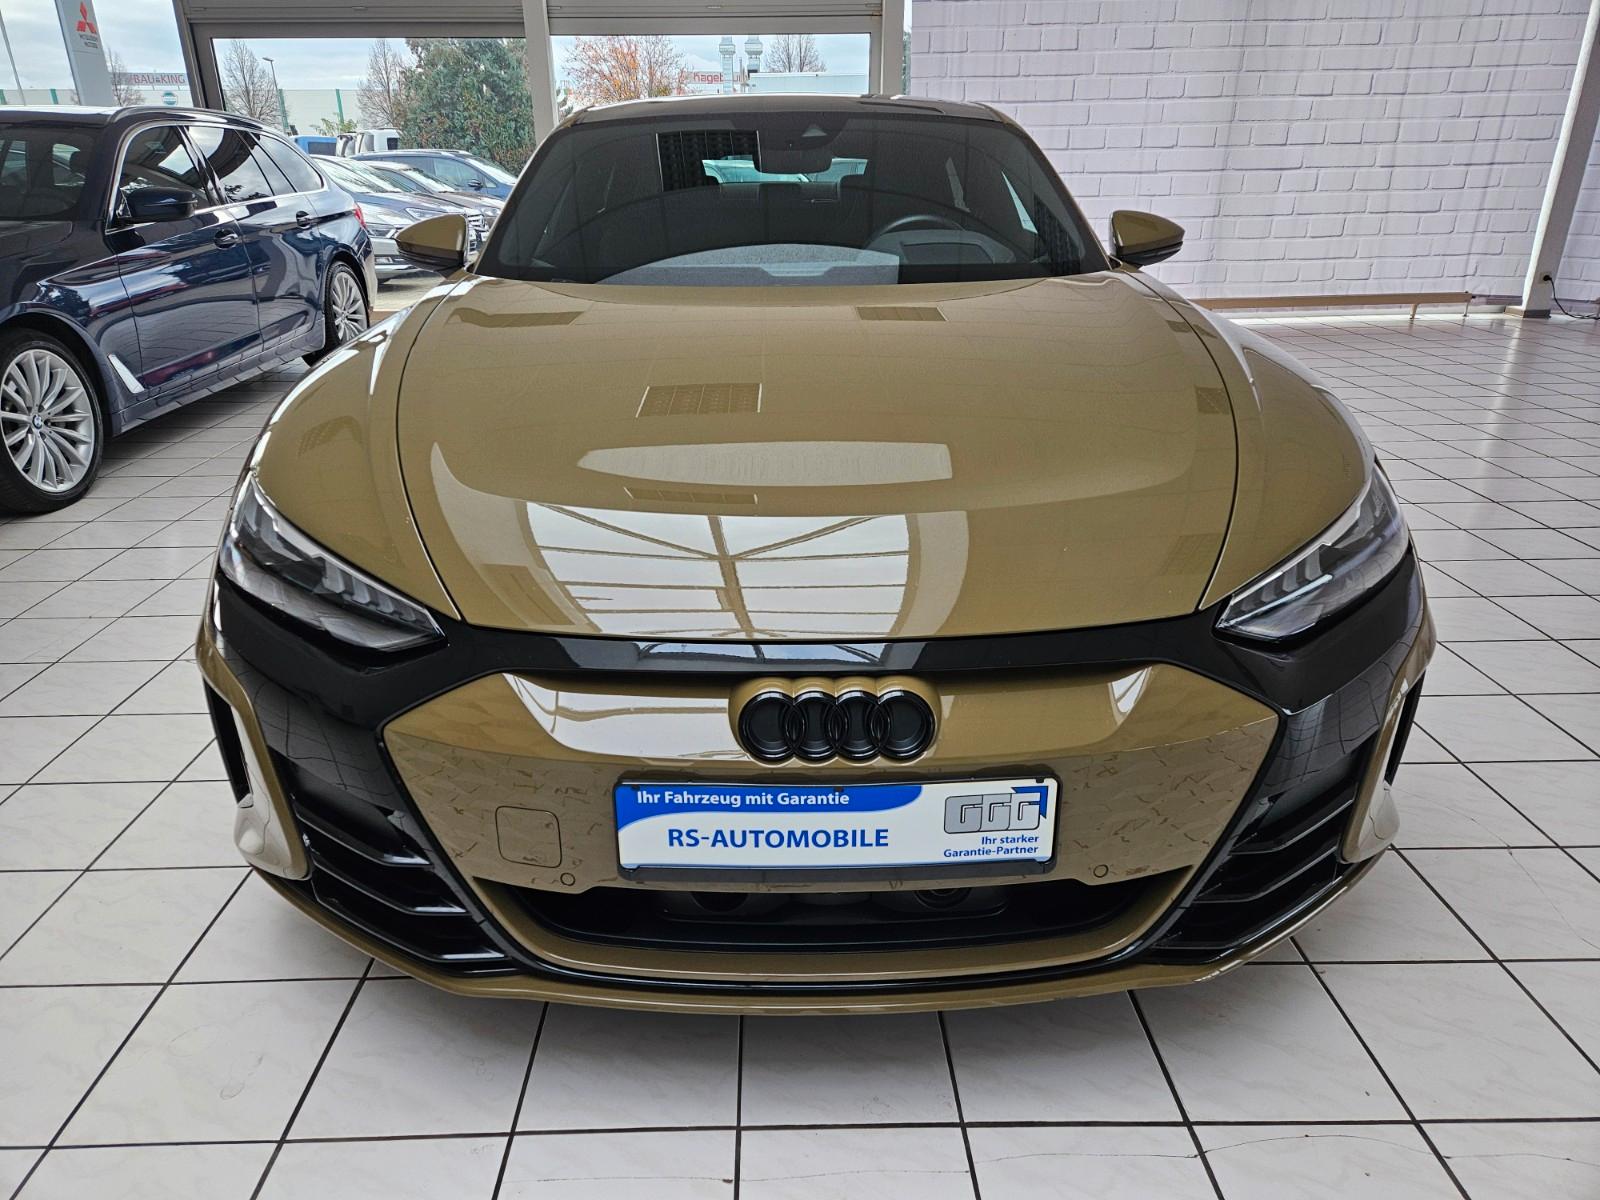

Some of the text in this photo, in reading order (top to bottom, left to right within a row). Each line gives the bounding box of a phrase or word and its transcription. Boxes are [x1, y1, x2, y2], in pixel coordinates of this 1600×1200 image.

[637, 791, 850, 808] Ihr Fahrzeug mit Garantie
[668, 828, 889, 849] RS-AUTOMOBILE
[981, 835, 1039, 845] Ihr starker
[943, 845, 1039, 858] Garantie-Partner
